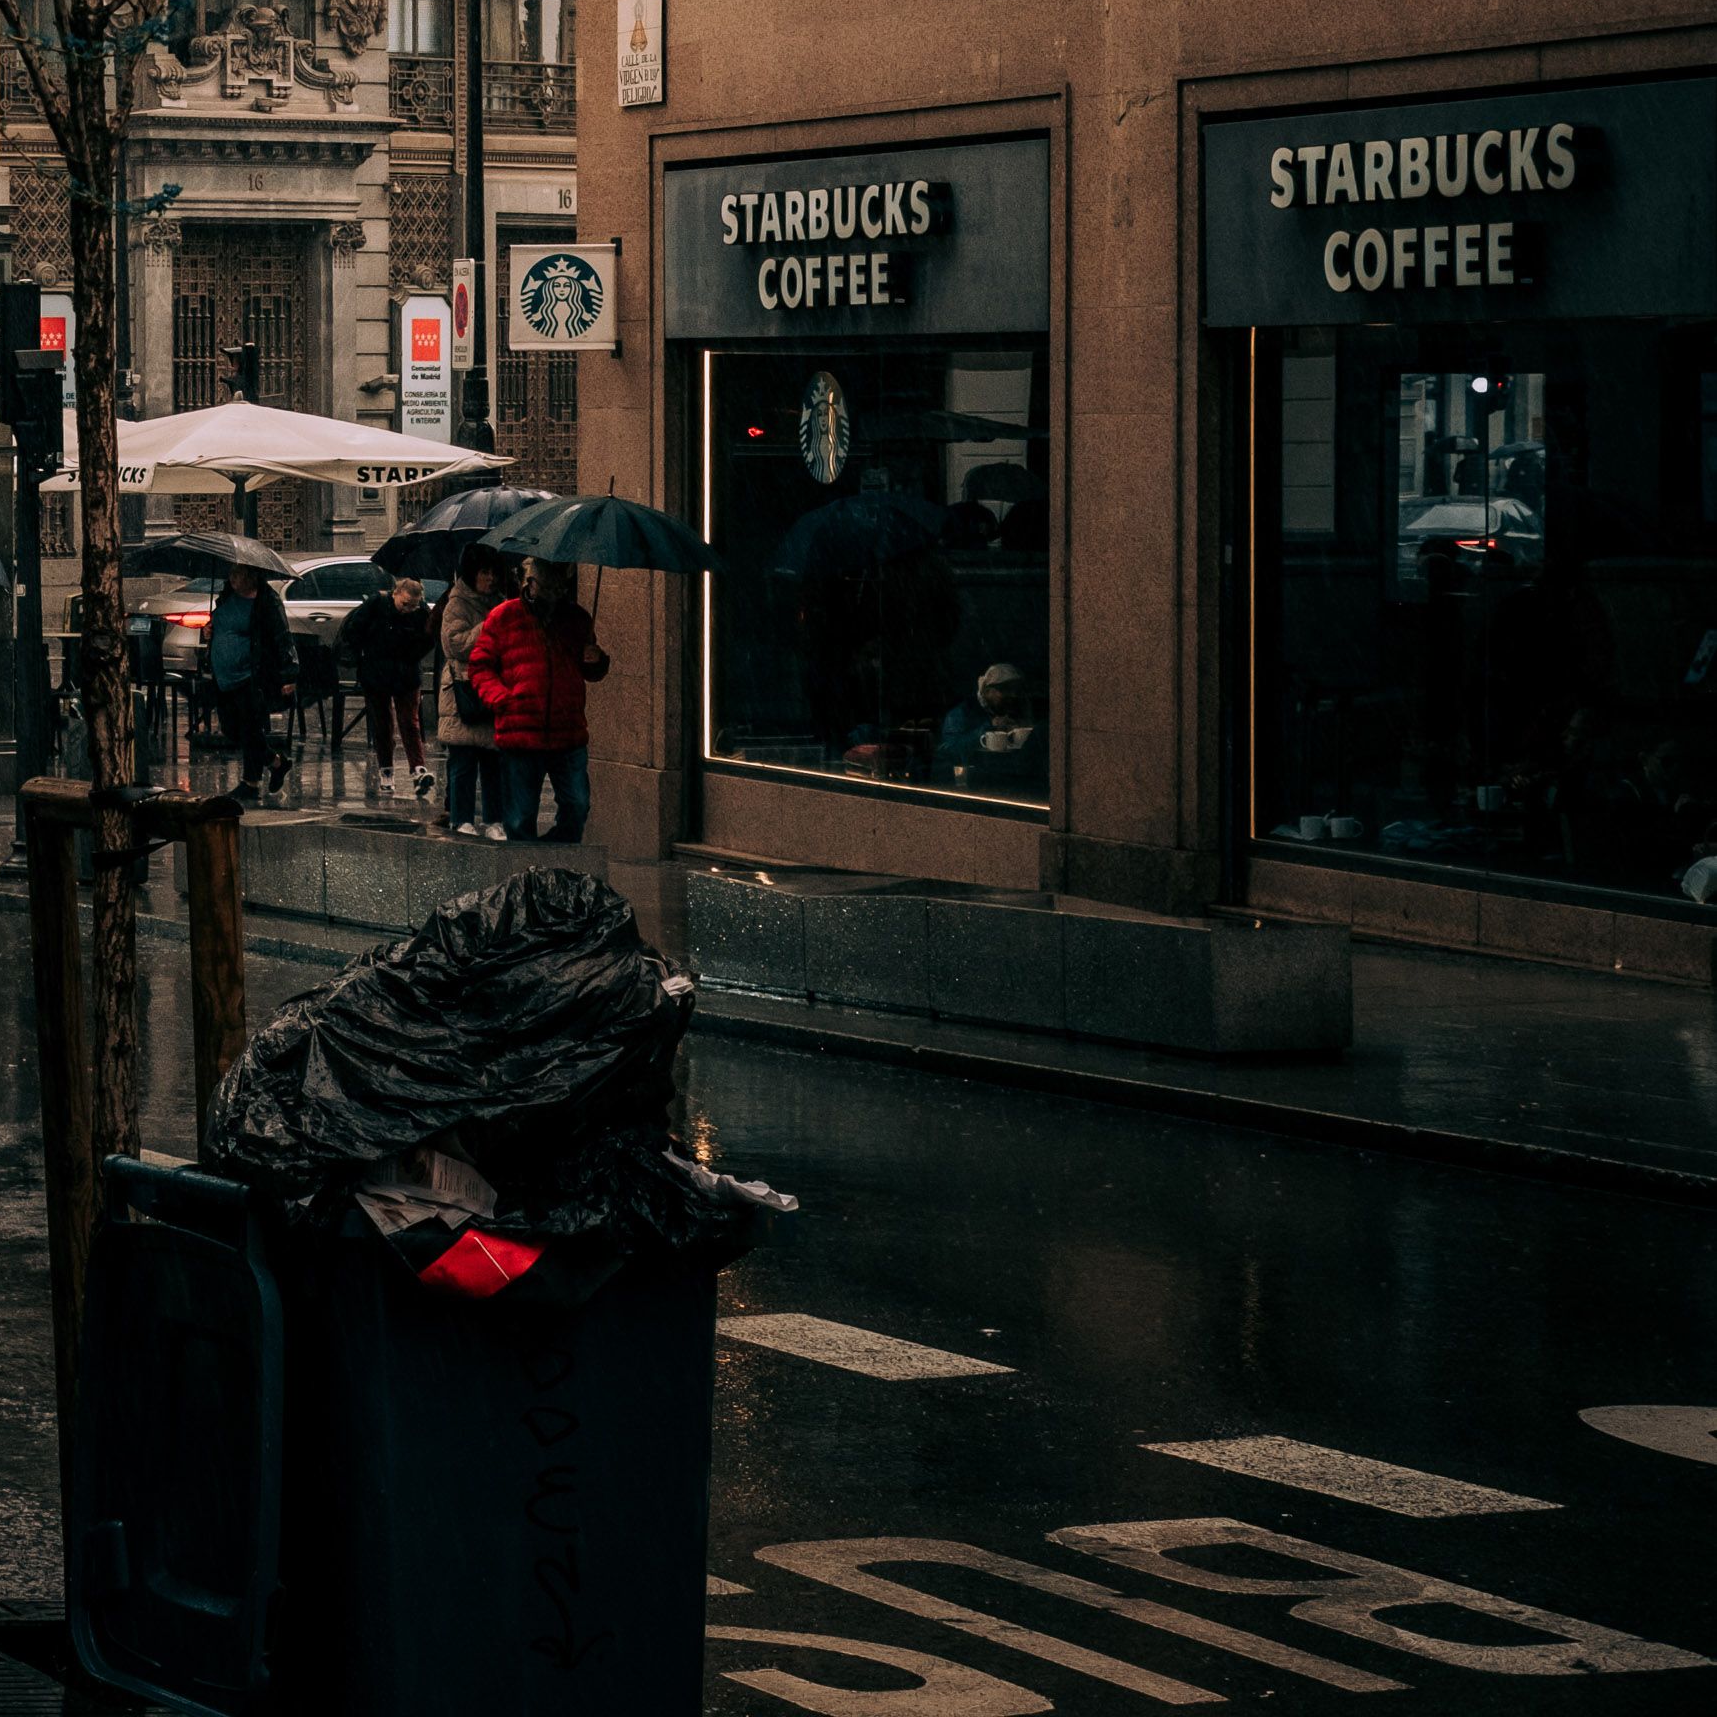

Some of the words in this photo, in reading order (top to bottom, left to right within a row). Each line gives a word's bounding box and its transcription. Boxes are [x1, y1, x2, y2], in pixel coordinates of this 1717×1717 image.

[557, 188, 573, 210] 16
[1271, 123, 1576, 209] STARBUCKS
[720, 179, 931, 245] STARBUCKS
[758, 253, 890, 310] COFFEE
[1323, 222, 1514, 293] COFFEE
